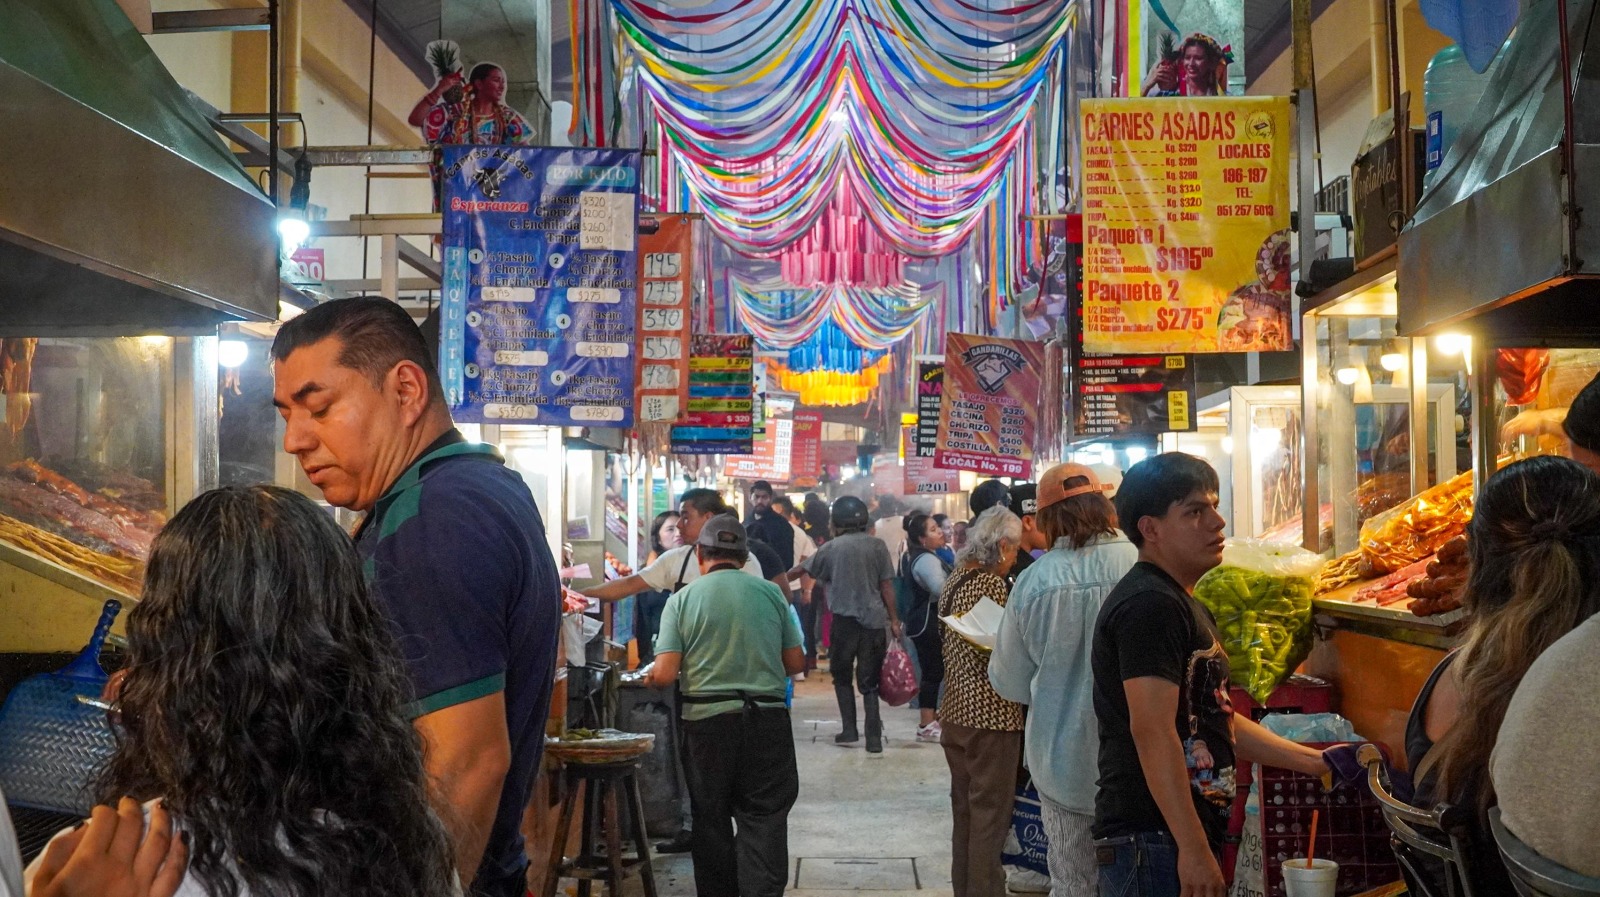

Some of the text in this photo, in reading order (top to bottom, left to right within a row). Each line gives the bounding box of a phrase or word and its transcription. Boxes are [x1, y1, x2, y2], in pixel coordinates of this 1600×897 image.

[1085, 110, 1236, 141] CARNES ASADAS
[1178, 143, 1197, 152] $320
[1218, 144, 1271, 159] LOCALES
[1178, 157, 1198, 166] $200
[1086, 173, 1110, 182] CECINA
[1179, 171, 1198, 180] $260
[1222, 167, 1268, 183] 196-197
[1086, 186, 1117, 195] COSTILLA
[1179, 184, 1201, 194] $320
[1235, 187, 1253, 198] TEL:
[451, 196, 529, 214] Esperanza
[583, 196, 606, 208] $320
[1180, 197, 1202, 207] $320
[535, 206, 580, 217] Chorizo
[583, 210, 606, 219] $200
[1235, 205, 1251, 216] 257
[523, 220, 580, 231] Enchilada
[582, 222, 606, 232] $260
[1088, 225, 1165, 246] Paquete 1
[499, 252, 534, 264] Tasajo
[584, 253, 619, 266] Tasajo
[495, 264, 537, 275] Chorizo
[581, 265, 623, 275] Chorizo
[646, 253, 680, 277] 195
[495, 276, 549, 287] Enchilada
[580, 278, 633, 289] Enchilada
[578, 290, 601, 302] $275
[645, 281, 678, 304] 275
[1088, 279, 1180, 304] Paquete 2
[645, 309, 680, 329] 390
[505, 328, 556, 339] Enchilada
[645, 337, 681, 359] 550
[971, 345, 1019, 361] GANDARILLAS
[503, 369, 539, 381] Tasajo
[496, 380, 538, 392] Chorizo
[952, 400, 1025, 416] TASAJO $320
[735, 415, 750, 423] 320
[950, 411, 1024, 425] CECINA $260
[949, 421, 990, 432] CHORIZO
[1001, 427, 1023, 436] $200
[949, 430, 1022, 445] TRIPA $400
[947, 440, 1021, 456] COSTILLA $320
[942, 456, 978, 468] LOCAL
[981, 461, 998, 471] No.
[1003, 463, 1022, 473] 199
[917, 482, 948, 493] #201
